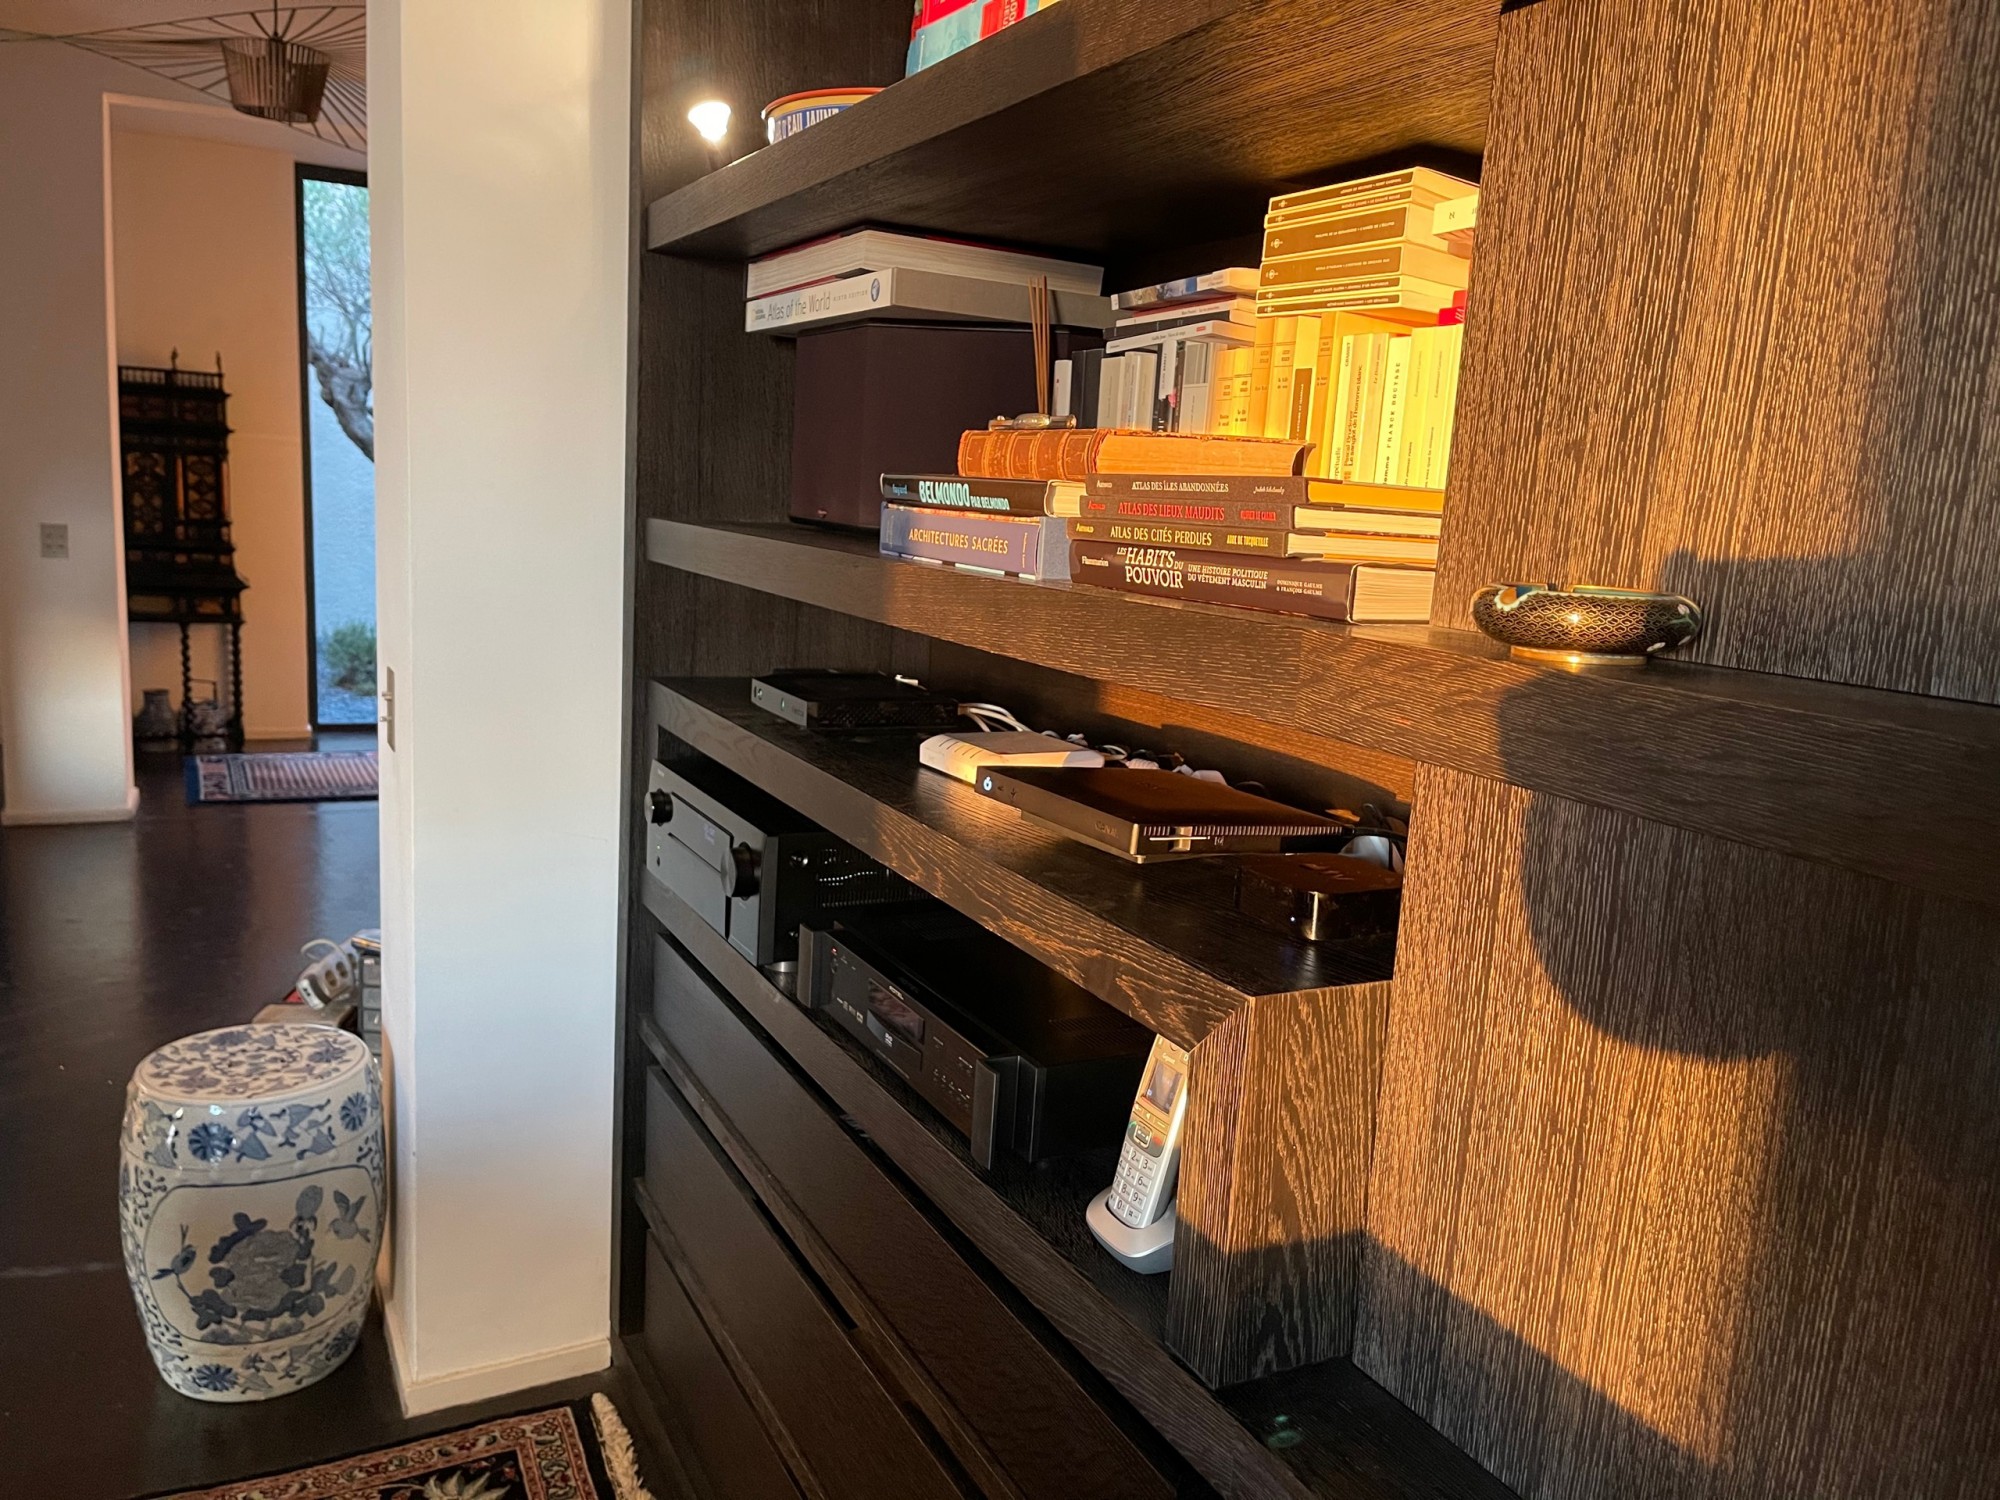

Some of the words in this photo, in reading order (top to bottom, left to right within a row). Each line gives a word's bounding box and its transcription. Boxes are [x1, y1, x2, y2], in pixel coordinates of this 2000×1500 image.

[767, 302, 784, 321] Atlas
[786, 300, 794, 319] of
[795, 297, 806, 316] the
[809, 291, 831, 313] World
[1354, 364, 1362, 385] blanc
[1387, 411, 1395, 448] FRANCK
[1343, 445, 1351, 467] Pascal
[918, 480, 971, 508] BELMONDO
[970, 495, 981, 508] PAR
[981, 496, 1010, 511] BELMONDO
[1131, 481, 1151, 491] ATLAS
[1151, 481, 1163, 491] DES
[1163, 479, 1178, 492] ÎLES
[1178, 481, 1229, 493] ABANDONNÉES
[1118, 502, 1142, 516] ATLAS
[1143, 503, 1158, 517] DES
[1159, 504, 1184, 518] LIEUX
[1184, 505, 1225, 521] MAUDITS
[908, 528, 969, 549] ARCHITECTURES
[971, 535, 1009, 555] SACRÉES
[1110, 525, 1132, 539] ATLAS
[1134, 527, 1149, 541] DES
[1150, 526, 1172, 543] CITÉS
[1174, 530, 1213, 546] PERDUES
[1116, 547, 1127, 556] LES
[1125, 547, 1176, 569] HABITS
[1174, 561, 1184, 570] DU
[1125, 566, 1184, 589] POUVOIR
[1187, 572, 1197, 582] DU
[1198, 572, 1231, 586] VÊTEMENT
[1231, 576, 1267, 590] MASCULIN
[1188, 564, 1202, 574] UNE
[1202, 564, 1231, 576] HISTOIRE
[1232, 567, 1269, 580] POLITIQUE
[1131, 1151, 1137, 1161] 2
[1142, 1160, 1149, 1170] 3
[1126, 1167, 1132, 1177] 5
[1137, 1177, 1143, 1186] 6
[1121, 1184, 1127, 1193] 8
[1132, 1192, 1139, 1202] 9
[1117, 1199, 1123, 1210] 0
